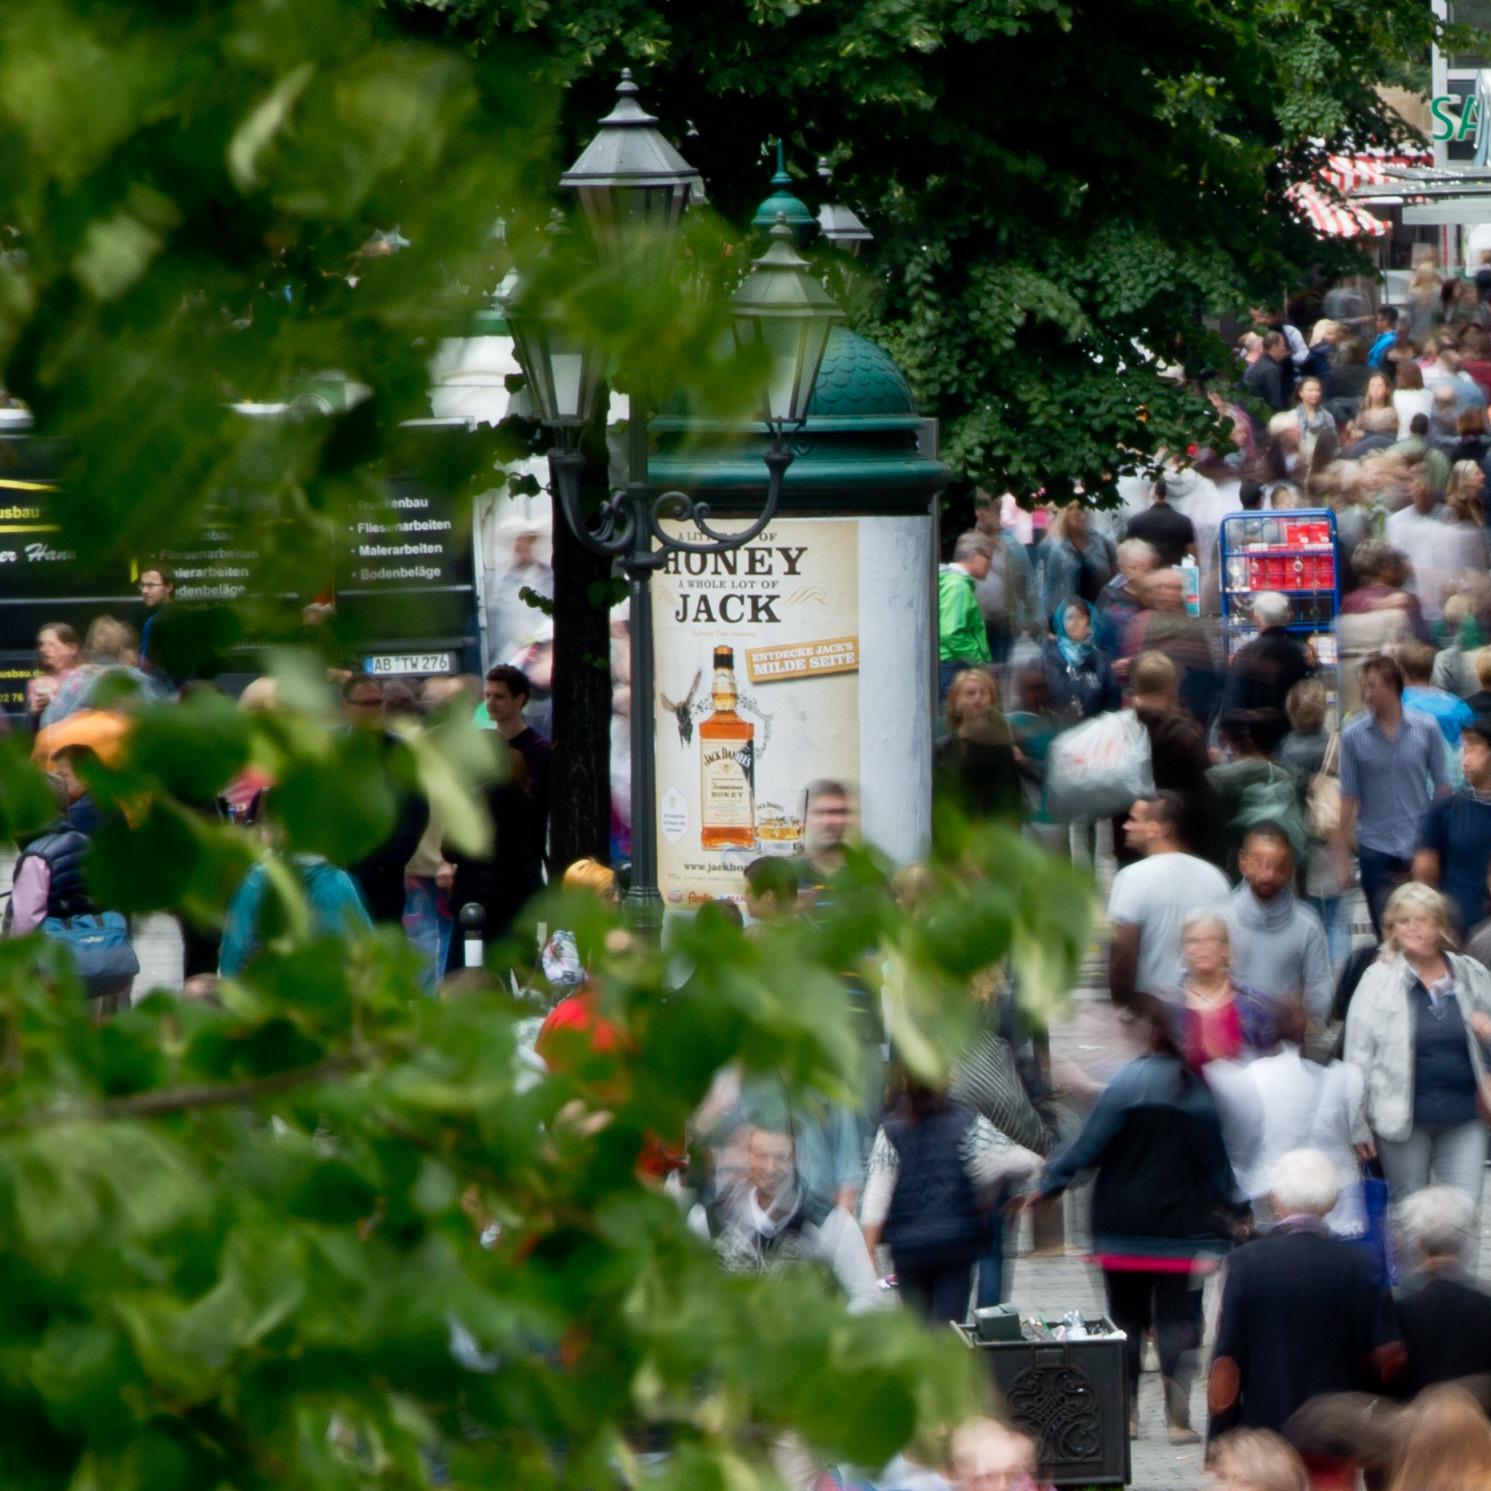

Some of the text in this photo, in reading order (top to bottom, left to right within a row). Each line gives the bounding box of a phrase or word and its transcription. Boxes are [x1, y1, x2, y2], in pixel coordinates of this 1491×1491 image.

[759, 532, 779, 542] OF
[358, 542, 444, 557] Malerarbeiten
[359, 565, 442, 581] Bodenbeläge
[678, 580, 780, 589] A WHOLE LOT OF
[675, 593, 782, 623] JACK
[373, 656, 391, 672] AB
[421, 653, 448, 669] 276
[753, 652, 855, 676] MILDE SEITE
[711, 791, 744, 799] HONEY
